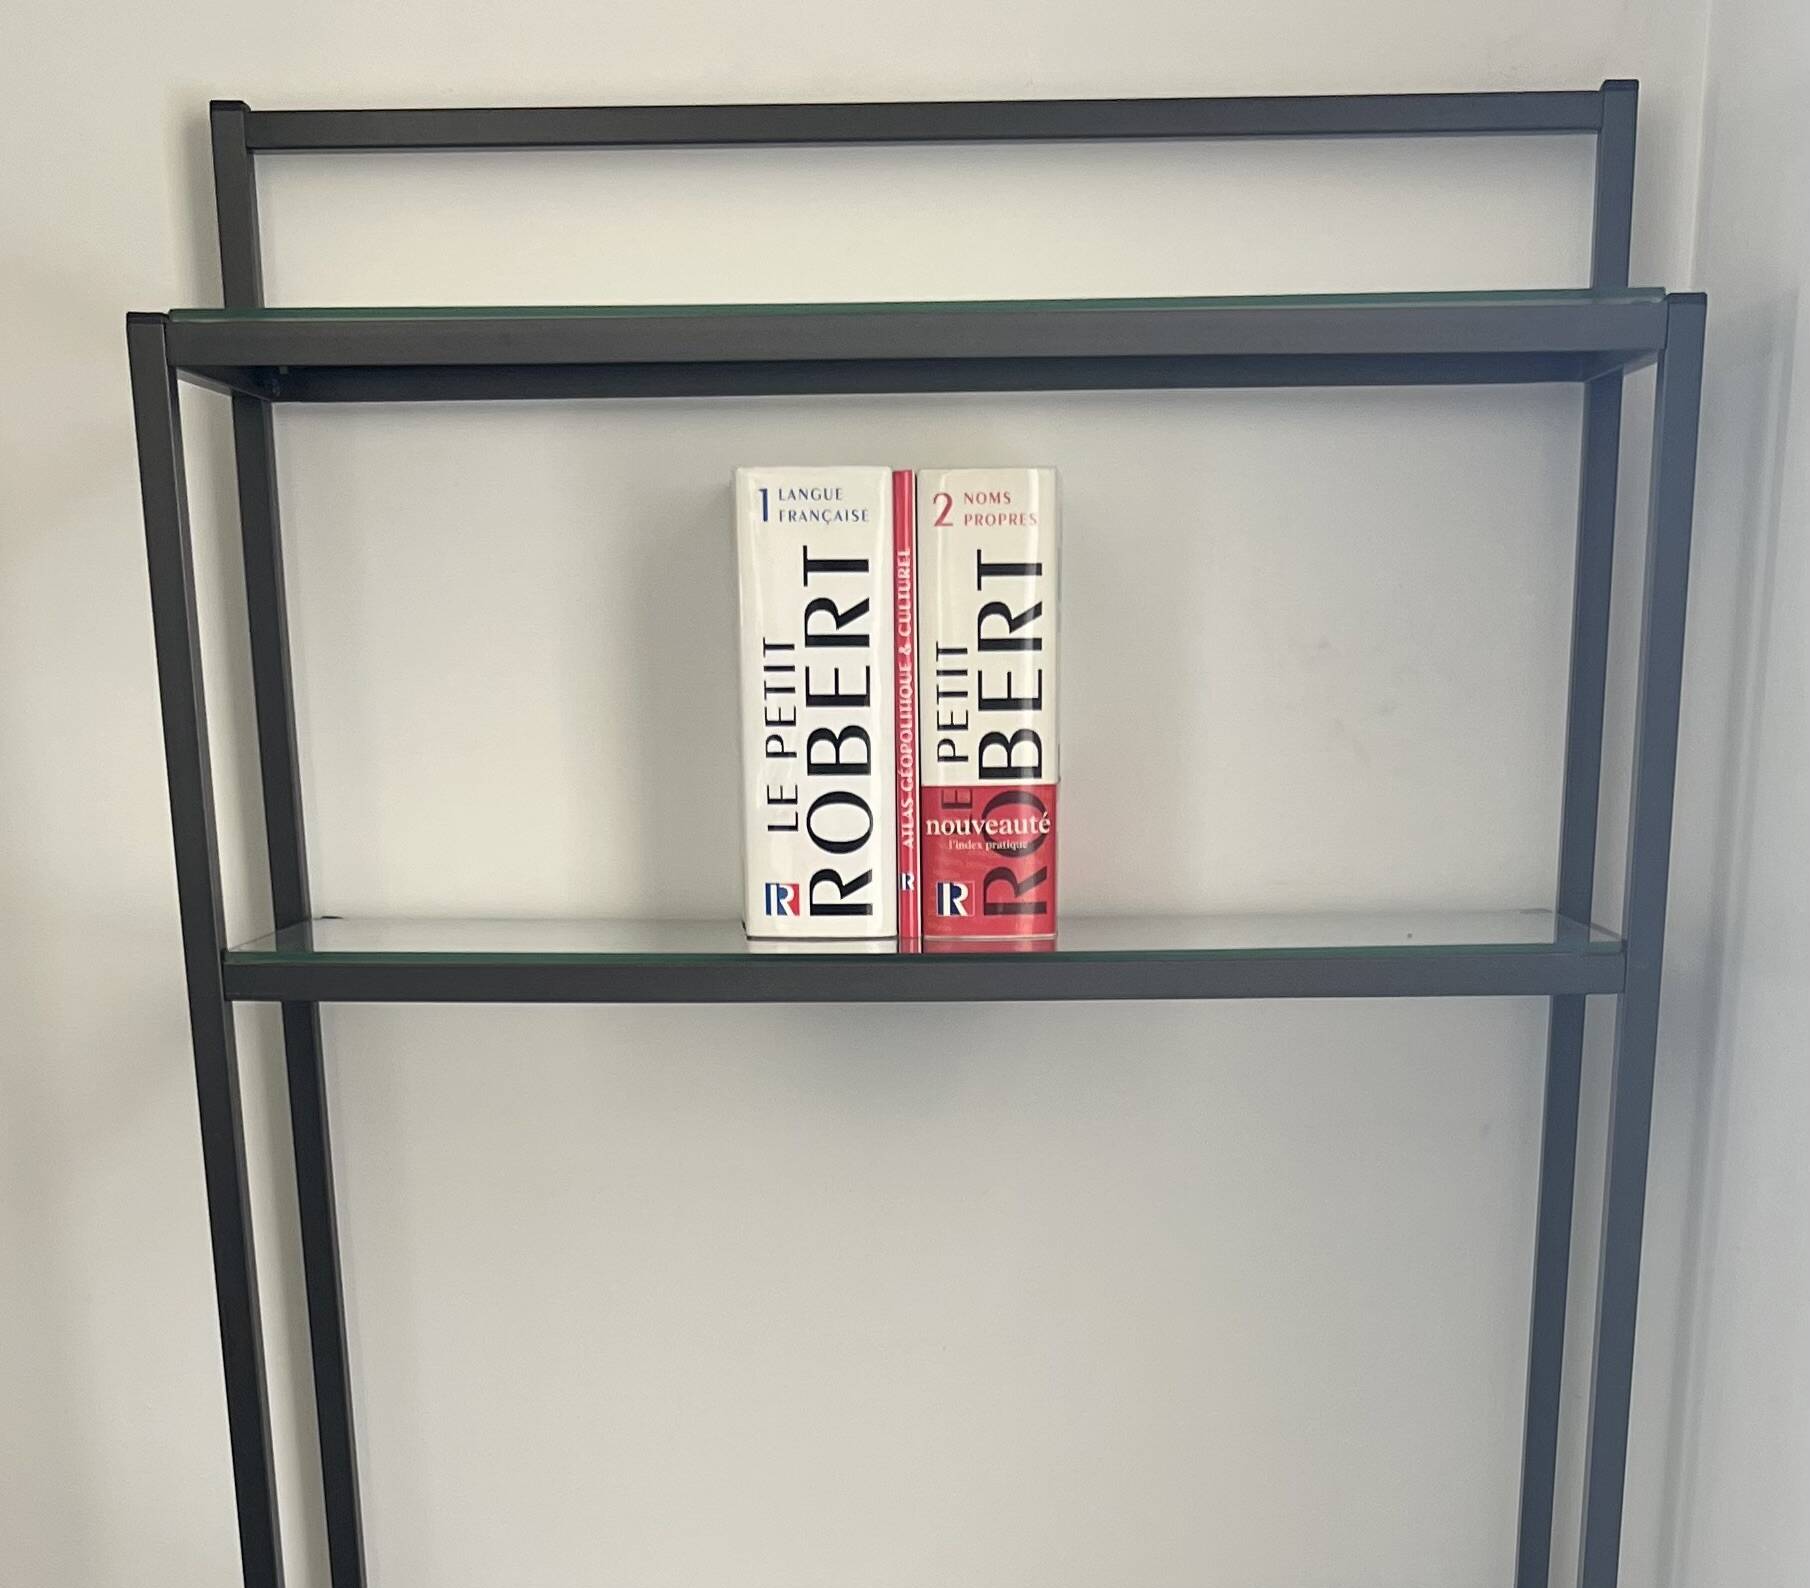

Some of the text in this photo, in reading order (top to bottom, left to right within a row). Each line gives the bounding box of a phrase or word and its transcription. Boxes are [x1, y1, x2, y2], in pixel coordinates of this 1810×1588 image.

[758, 488, 842, 522] 1 LANGUE
[779, 509, 869, 523] FRANÇAISE
[932, 491, 1011, 527] 2 NOMS
[964, 513, 1038, 526] PROPRES
[897, 548, 912, 637] CULTUREL
[763, 637, 798, 832] LE PETIT
[803, 545, 873, 916] ROBERT
[898, 661, 914, 792] GÉOPOLITIQUE
[936, 641, 969, 762] PETIT
[977, 549, 1048, 916] ROBERT
[901, 798, 914, 848] ATLAS
[926, 811, 1051, 835] nouveauté
